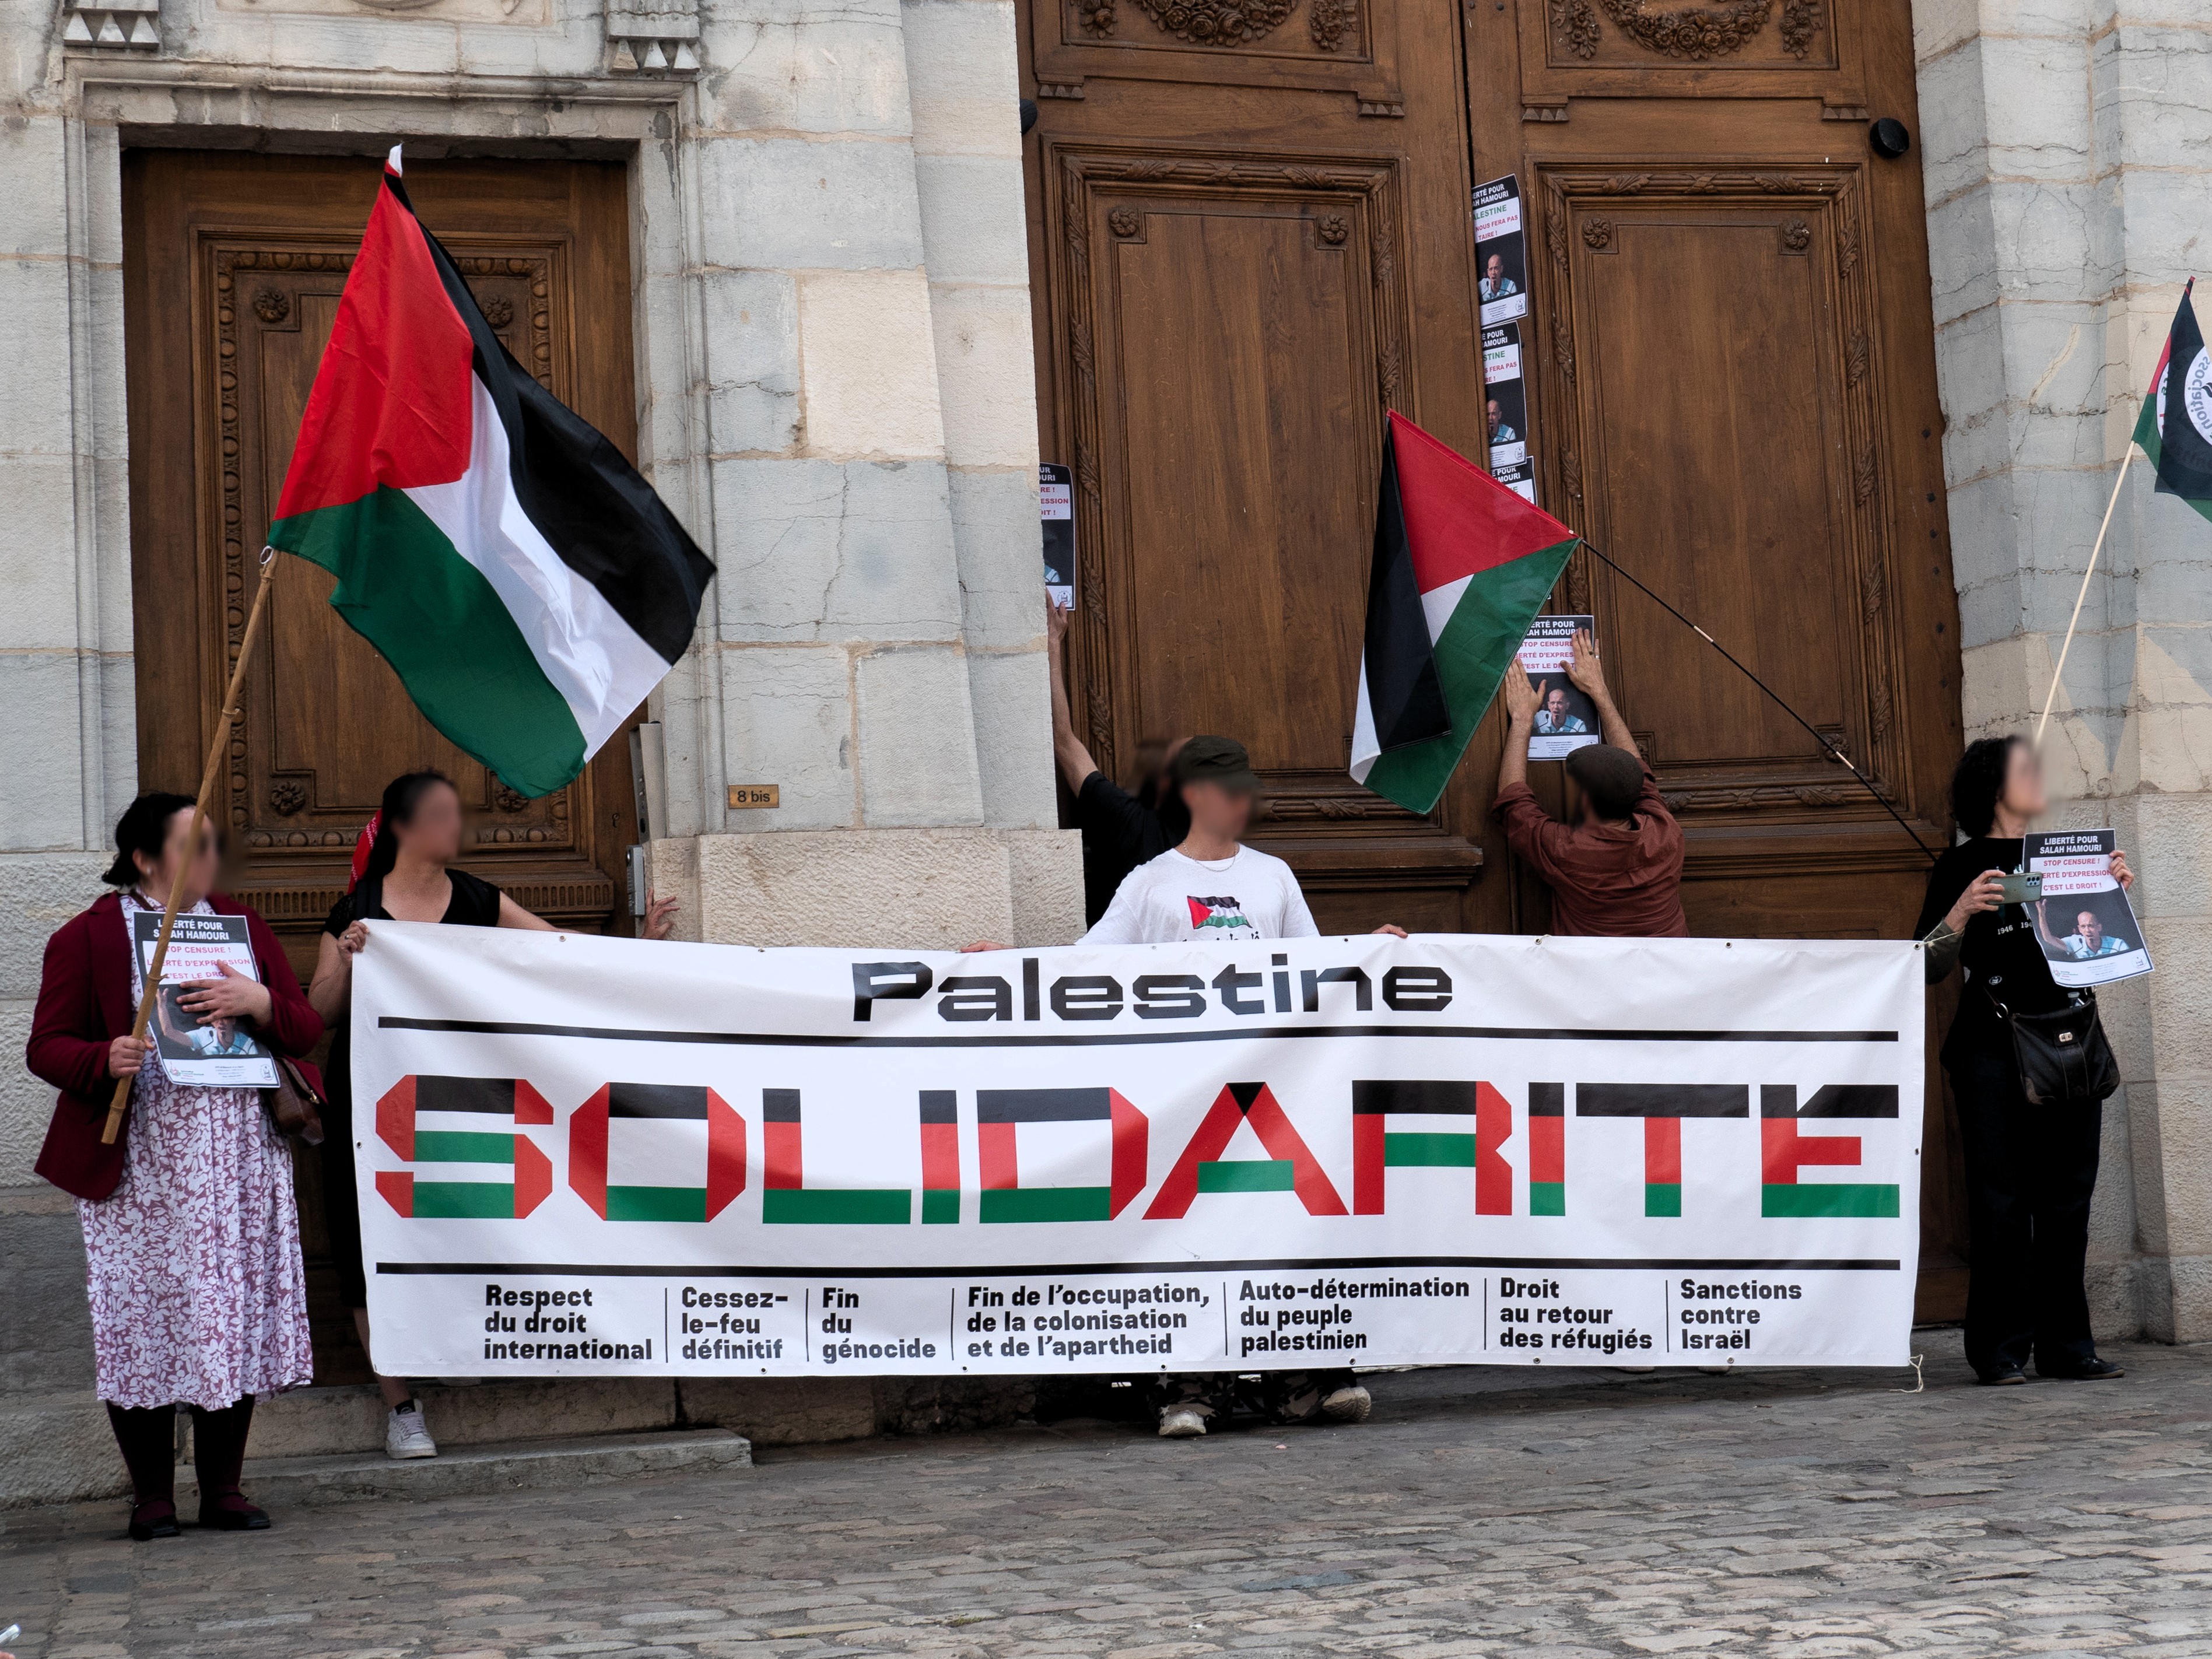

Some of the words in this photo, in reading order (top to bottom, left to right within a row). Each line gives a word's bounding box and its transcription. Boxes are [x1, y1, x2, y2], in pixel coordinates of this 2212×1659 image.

[1473, 187, 1487, 199] ERTÉ
[1488, 184, 1505, 194] POUR
[1481, 191, 1509, 204] HAMOURI
[1473, 205, 1507, 220] ALESTINE
[1475, 223, 1491, 232] NOUS
[1492, 219, 1506, 227] FERA
[1507, 215, 1518, 223] PAS
[1478, 232, 1494, 240] TAIRE
[1483, 336, 1508, 348] AMOURI
[1487, 329, 1504, 339] POUR
[1483, 350, 1505, 362] STINE
[1489, 364, 1505, 372] FERA
[1497, 467, 1516, 475] POUR
[1530, 620, 1551, 628] ERTÉ
[737, 790, 747, 802] 8
[751, 790, 770, 802] bis
[2045, 835, 2076, 845] LIBERTÉ
[2066, 844, 2101, 853] HAMOURI
[153, 929, 184, 939] SAH
[186, 930, 229, 940] HAMOURI
[157, 919, 195, 929] LERTÉ
[197, 921, 223, 930] POUR
[1997, 925, 2013, 935] 1946
[852, 953, 1453, 1022] Palestine
[682, 1286, 788, 1308] Cessez-
[968, 1286, 1003, 1307] Fin
[1011, 1285, 1040, 1306] de
[1048, 1282, 1210, 1310] l'occupation,
[1239, 1278, 1470, 1301] Auto-détermination
[1500, 1277, 1559, 1298] Droit
[1681, 1279, 1802, 1300] Sanctions
[486, 1285, 593, 1312] Respect
[822, 1288, 859, 1308] Fin
[485, 1311, 516, 1332] du
[524, 1311, 587, 1333] droit
[682, 1313, 760, 1334] le-feu
[822, 1313, 851, 1334] du
[967, 1311, 997, 1333] de
[1005, 1311, 1025, 1332] la
[1033, 1309, 1187, 1331] colonisation
[1241, 1306, 1270, 1326] du
[1277, 1304, 1352, 1331] peuple
[1500, 1307, 1529, 1324] au
[1537, 1306, 1613, 1324] retour
[1681, 1307, 1761, 1324] contre
[484, 1339, 652, 1359] international
[682, 1339, 783, 1359] définitif
[967, 1341, 993, 1357] et
[1001, 1337, 1030, 1357] de
[1037, 1334, 1172, 1361] l'apartheid
[1241, 1330, 1367, 1358] palestinien
[1500, 1327, 1544, 1349] des
[1551, 1327, 1652, 1355] réfugiés
[1682, 1329, 1751, 1349] Israël
[822, 1338, 936, 1365] génocide
